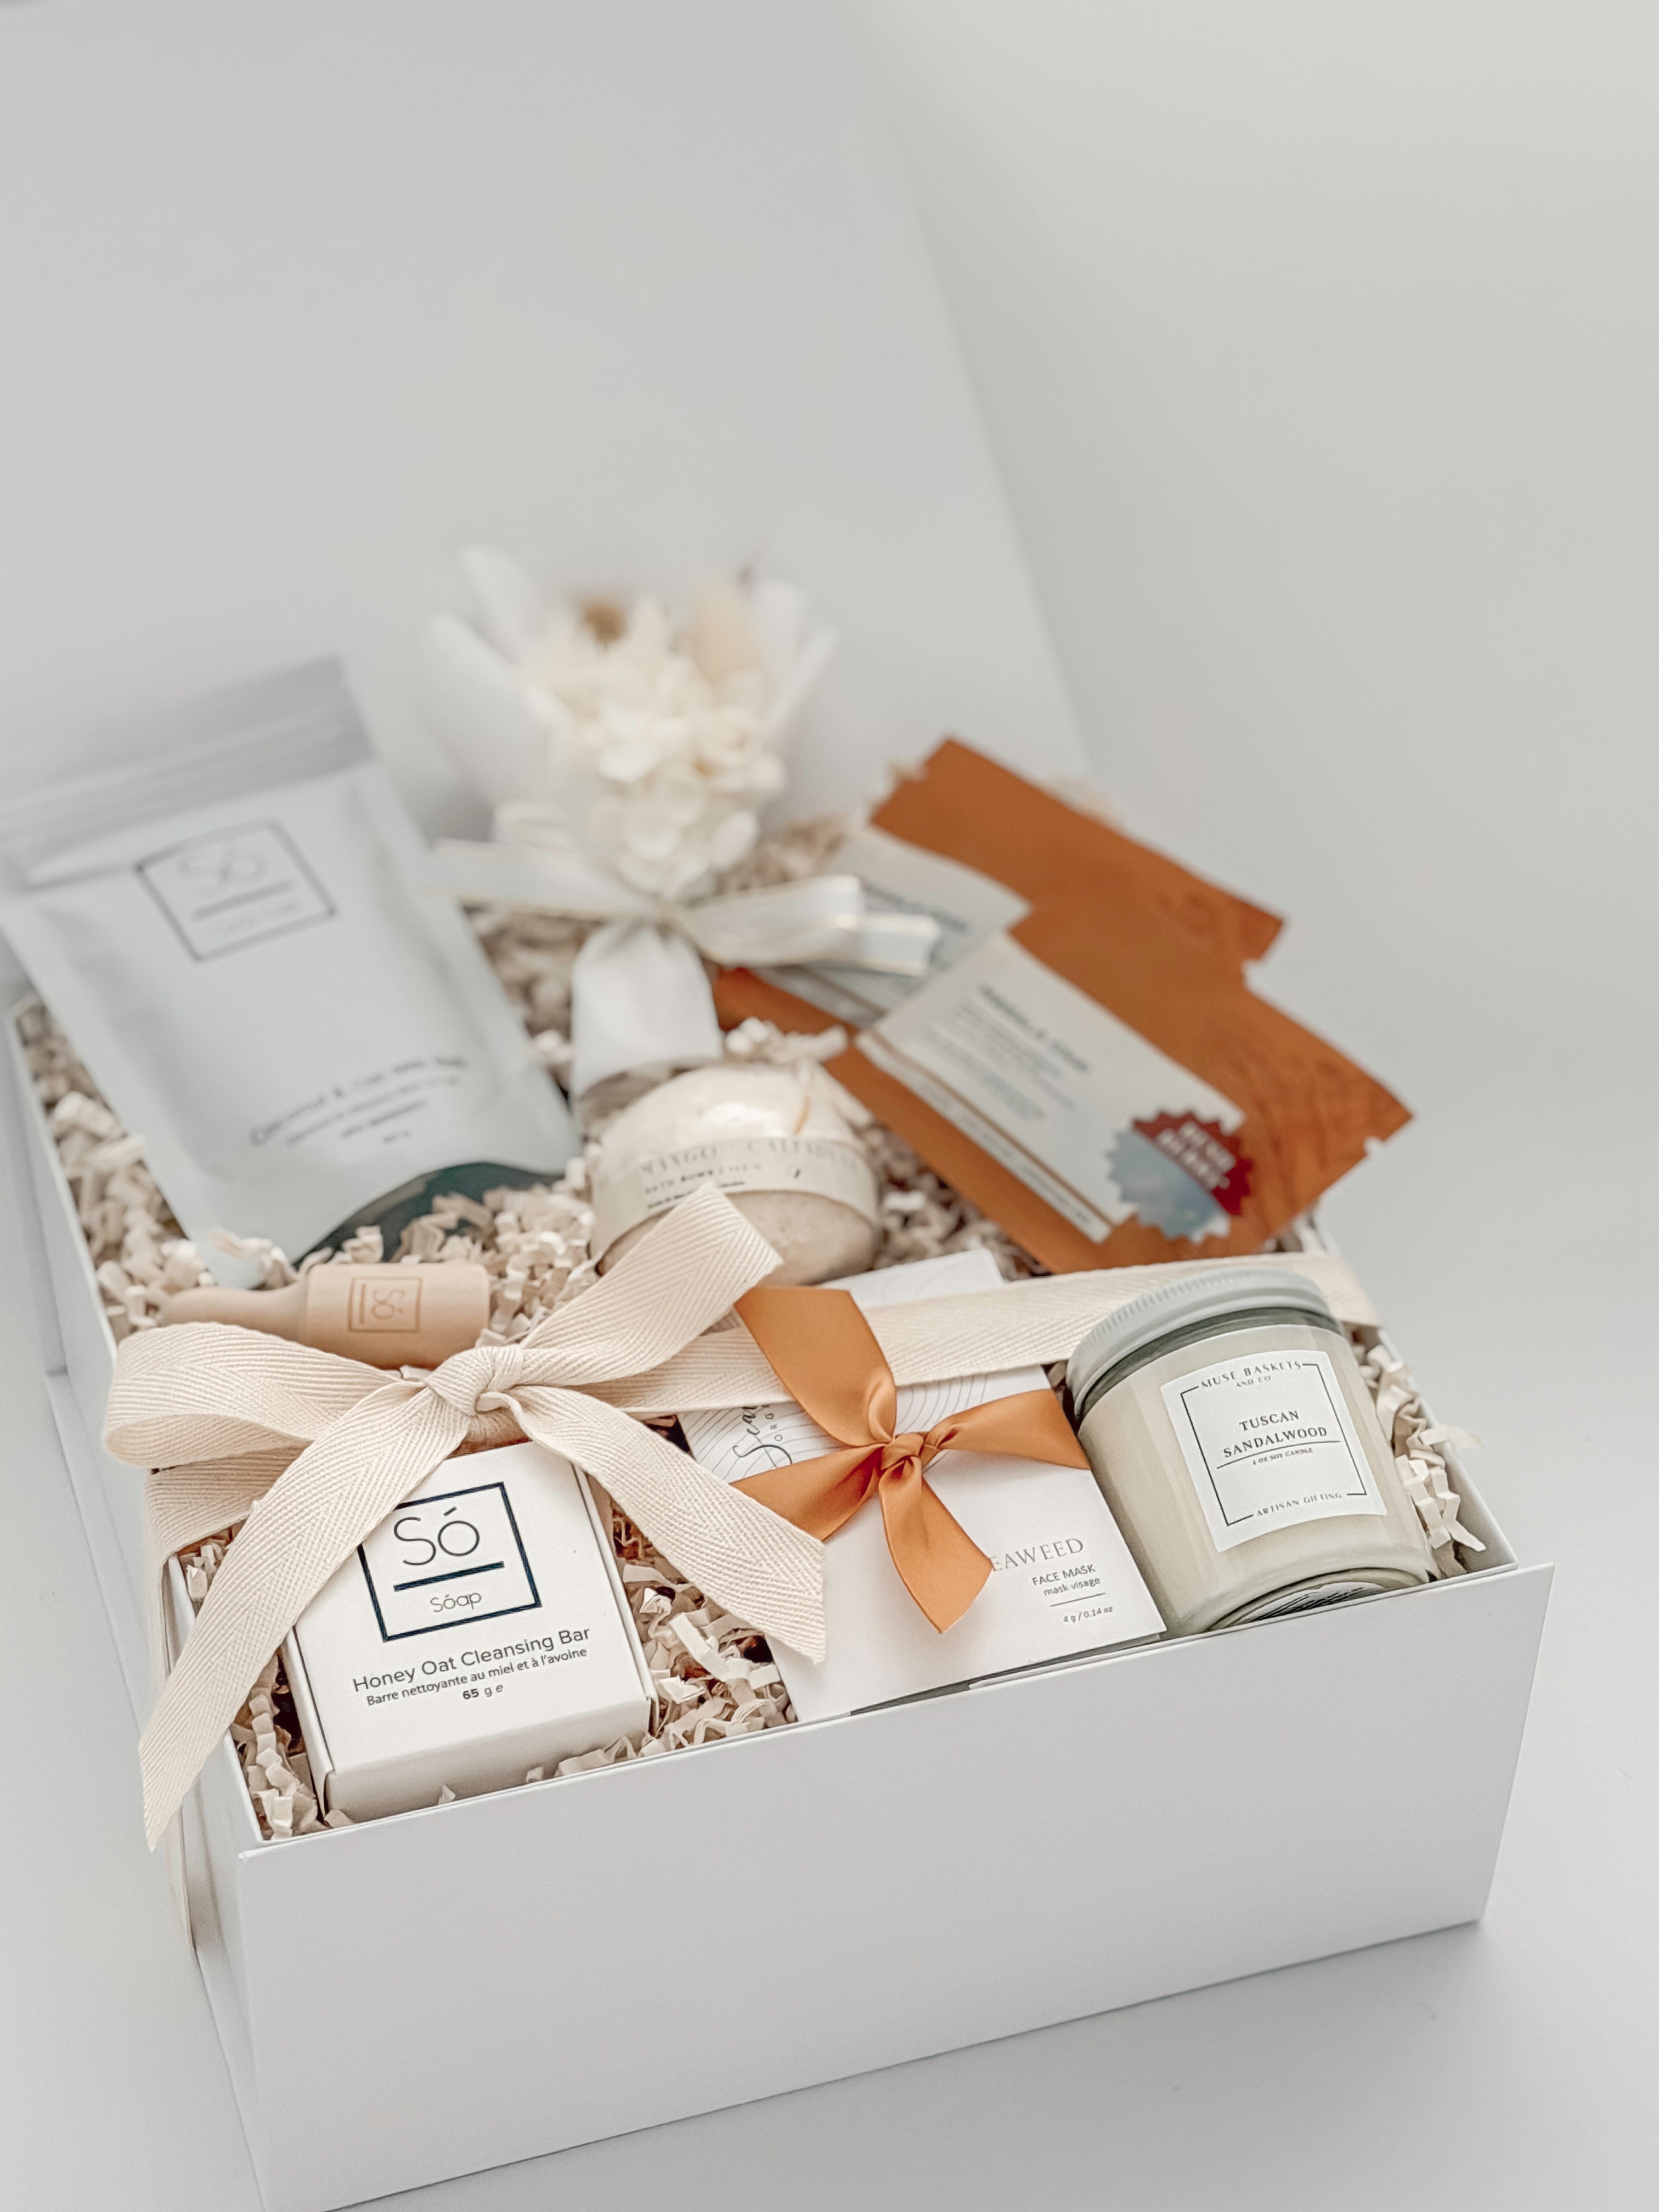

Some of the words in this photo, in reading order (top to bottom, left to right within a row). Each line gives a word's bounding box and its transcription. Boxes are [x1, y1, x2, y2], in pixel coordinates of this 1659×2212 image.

[1201, 1371, 1236, 1388] MUSE
[1243, 1361, 1302, 1376] BASKETS
[1239, 1409, 1300, 1431] TUSCAN
[1223, 1426, 1328, 1458] SANDALWOOD
[1256, 1499, 1300, 1517] ARTISAN
[393, 1506, 480, 1566] Só
[989, 1538, 1084, 1572] EAWEED
[1031, 1571, 1061, 1587] FACE
[1062, 1564, 1097, 1579] MASK
[1043, 1583, 1069, 1597] mask
[1070, 1577, 1101, 1590] visage
[430, 1592, 482, 1613] Sóap
[1083, 1607, 1102, 1619] 0.14
[353, 1667, 416, 1693] Honey
[421, 1656, 458, 1675] Oat
[460, 1636, 555, 1667] Cleansing
[558, 1628, 591, 1645] Bar
[366, 1691, 399, 1707] Barre
[402, 1675, 468, 1698] nettoyante
[470, 1671, 486, 1681] au
[488, 1662, 515, 1678] miel
[517, 1661, 530, 1671] et
[532, 1657, 539, 1668] à
[462, 1688, 480, 1700] 65
[484, 1686, 493, 1698] g
